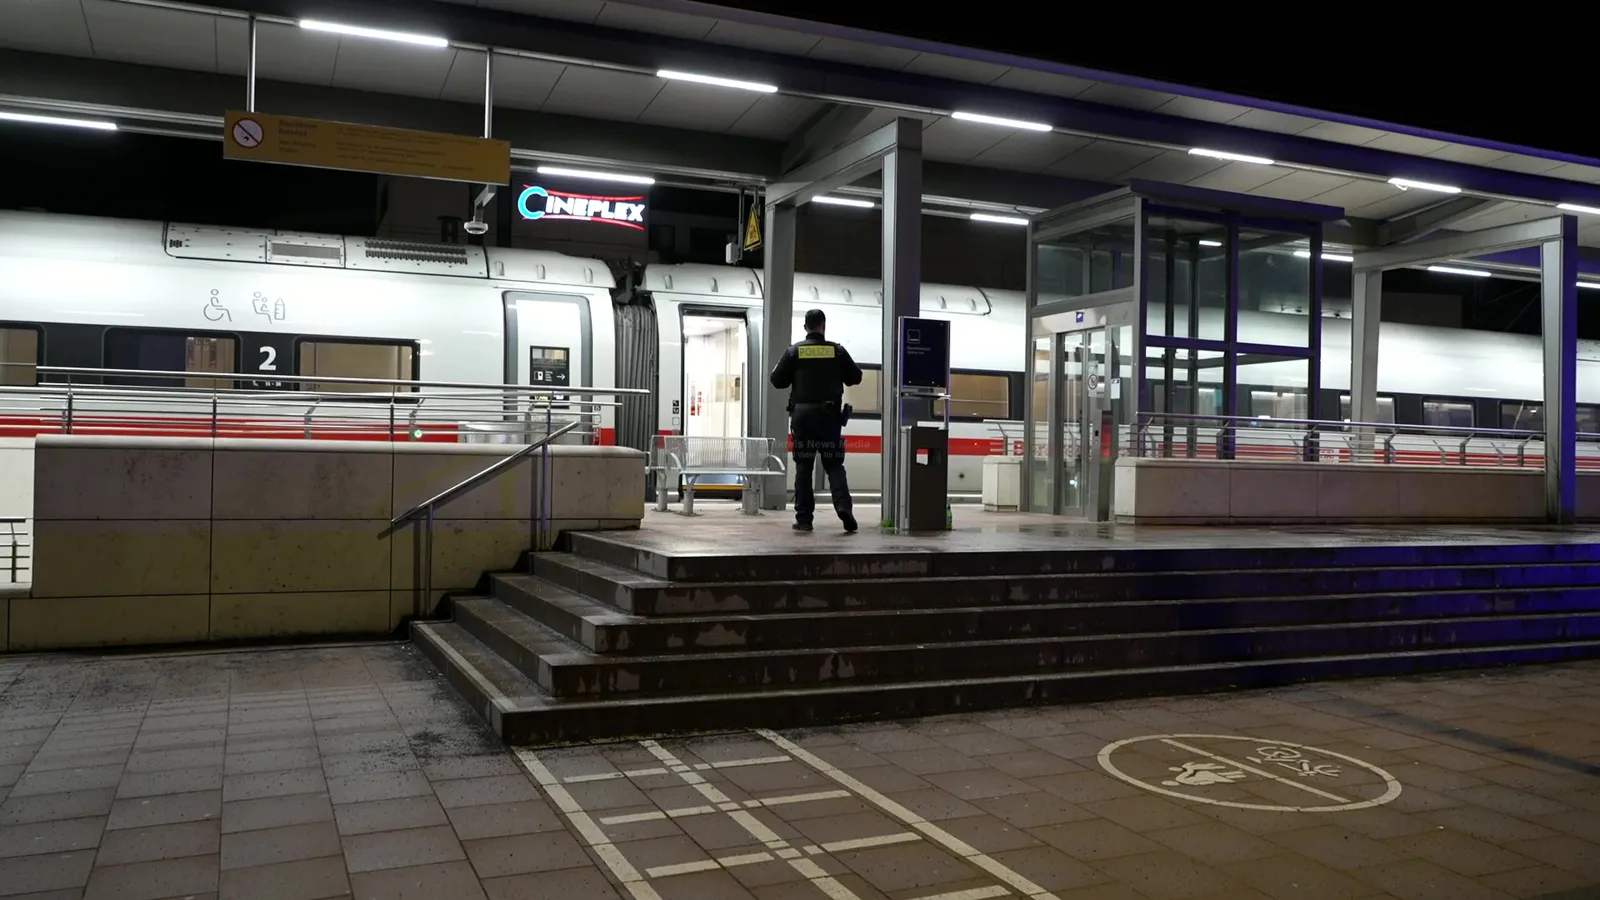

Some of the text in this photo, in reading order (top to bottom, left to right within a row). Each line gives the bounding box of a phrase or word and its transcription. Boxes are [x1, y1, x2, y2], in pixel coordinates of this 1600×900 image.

[518, 186, 646, 222] CINEPLEX
[258, 345, 277, 371] 2
[799, 347, 834, 357] POLIZEI
